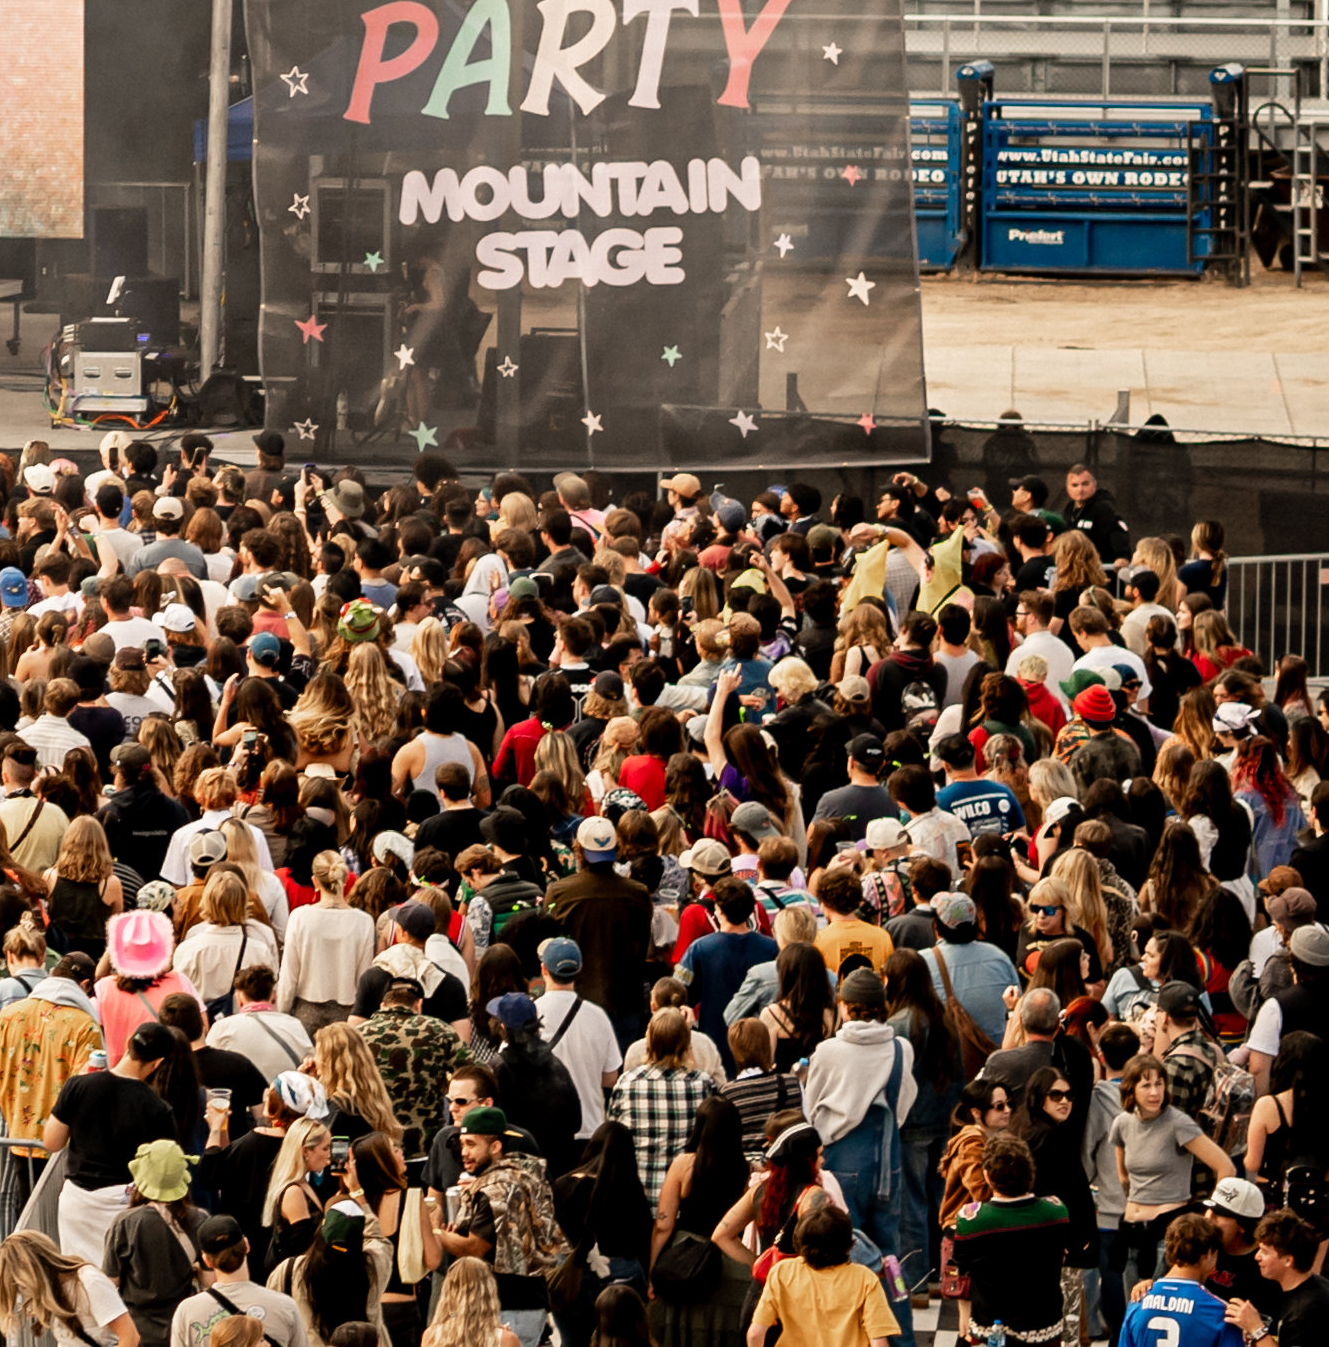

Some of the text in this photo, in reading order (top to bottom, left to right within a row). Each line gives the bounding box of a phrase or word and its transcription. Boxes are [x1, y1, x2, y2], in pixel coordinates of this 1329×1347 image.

[996, 169, 1066, 185] UTAH'S
[1071, 171, 1119, 186] OWN
[398, 156, 762, 226] MOUNTAIN
[476, 226, 686, 291] STAGE
[952, 800, 992, 820] WILCO
[1141, 1294, 1195, 1315] MALDINI
[1146, 1316, 1181, 1347] 3
